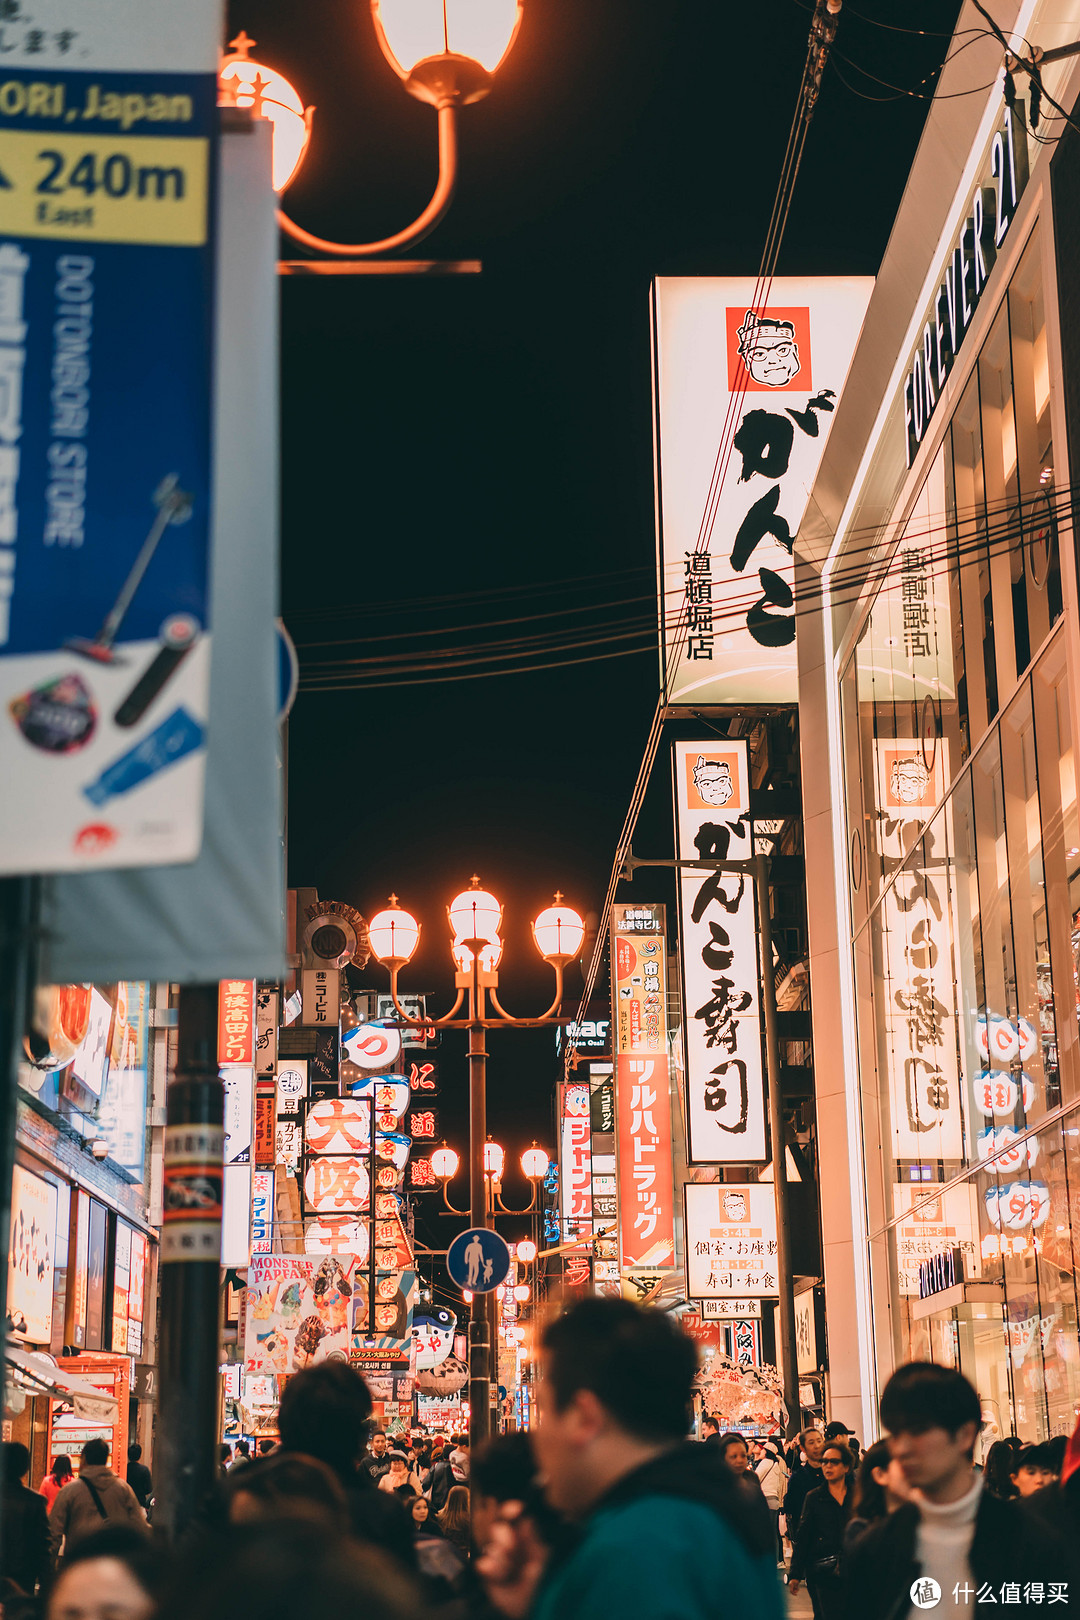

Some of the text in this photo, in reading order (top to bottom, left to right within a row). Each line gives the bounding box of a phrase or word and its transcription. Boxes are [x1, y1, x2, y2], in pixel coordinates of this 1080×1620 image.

[36, 150, 185, 199] 240m
[904, 184, 994, 470] FOREVER
[43, 254, 94, 548] DOTONBORI STORE
[730, 389, 836, 647] がんこ
[684, 551, 714, 661] 道頓堀店
[225, 982, 249, 1062] 豊後高田どり
[238, 1153, 249, 1162] 2F
[629, 1060, 662, 1239] ツルハドラッグ
[252, 1257, 313, 1271] MONSTER
[695, 1240, 777, 1256] 個室・お座敷
[705, 1272, 775, 1288] 寿司・和食
[706, 1301, 757, 1313] 個室・和食
[247, 1359, 264, 1372] 2F
[399, 1404, 411, 1413] 2F
